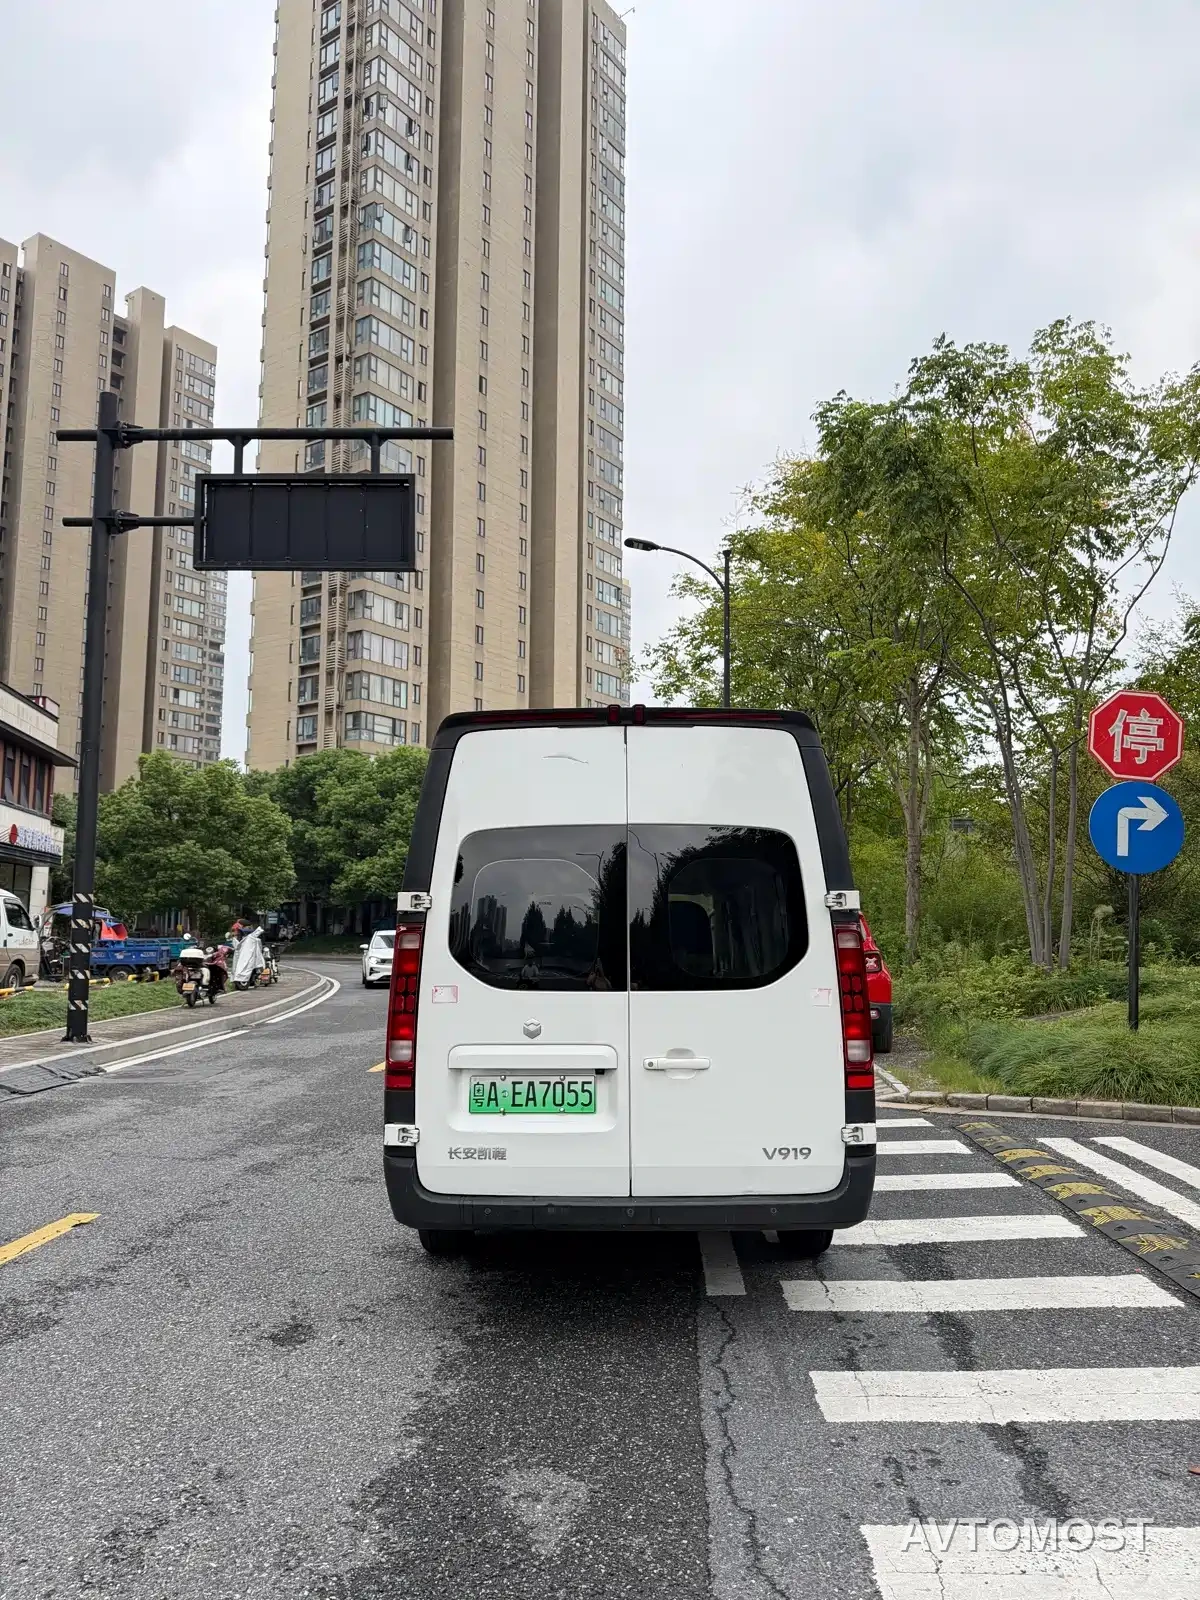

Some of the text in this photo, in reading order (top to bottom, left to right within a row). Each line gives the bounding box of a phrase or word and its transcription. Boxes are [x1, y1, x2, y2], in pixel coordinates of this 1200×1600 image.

[1108, 708, 1164, 764] 停
[511, 1081, 593, 1107] EA7055
[448, 1147, 507, 1160] 长安凯程
[762, 1147, 812, 1160] V919
